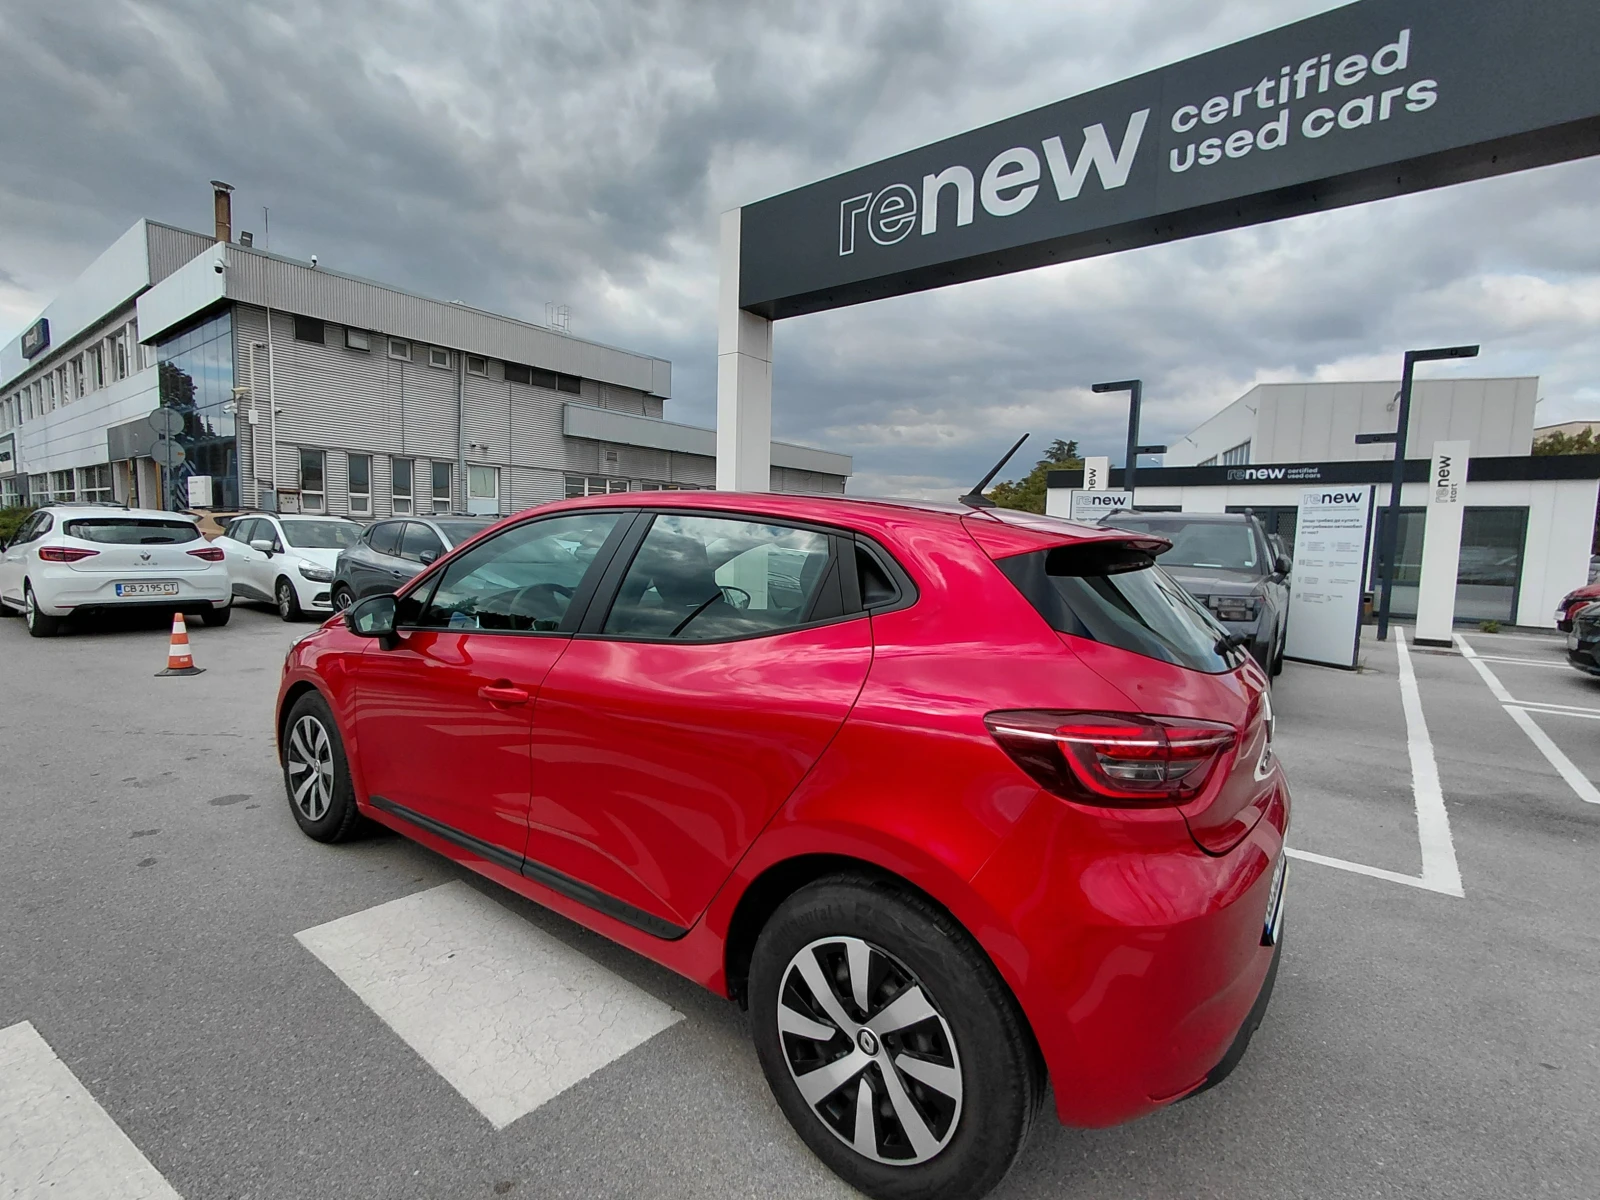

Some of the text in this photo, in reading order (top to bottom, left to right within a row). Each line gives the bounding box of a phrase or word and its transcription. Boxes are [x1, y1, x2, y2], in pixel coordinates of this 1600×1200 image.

[1171, 28, 1411, 133] certified
[1169, 79, 1439, 173] used cars
[838, 107, 1150, 257] renew
[1088, 468, 1097, 491] new
[1227, 468, 1286, 480] renew
[1435, 455, 1451, 503] renew
[1076, 495, 1127, 506] renew
[1303, 492, 1363, 505] renew
[1450, 483, 1458, 503] start
[123, 583, 176, 593] CB 2195 CT
